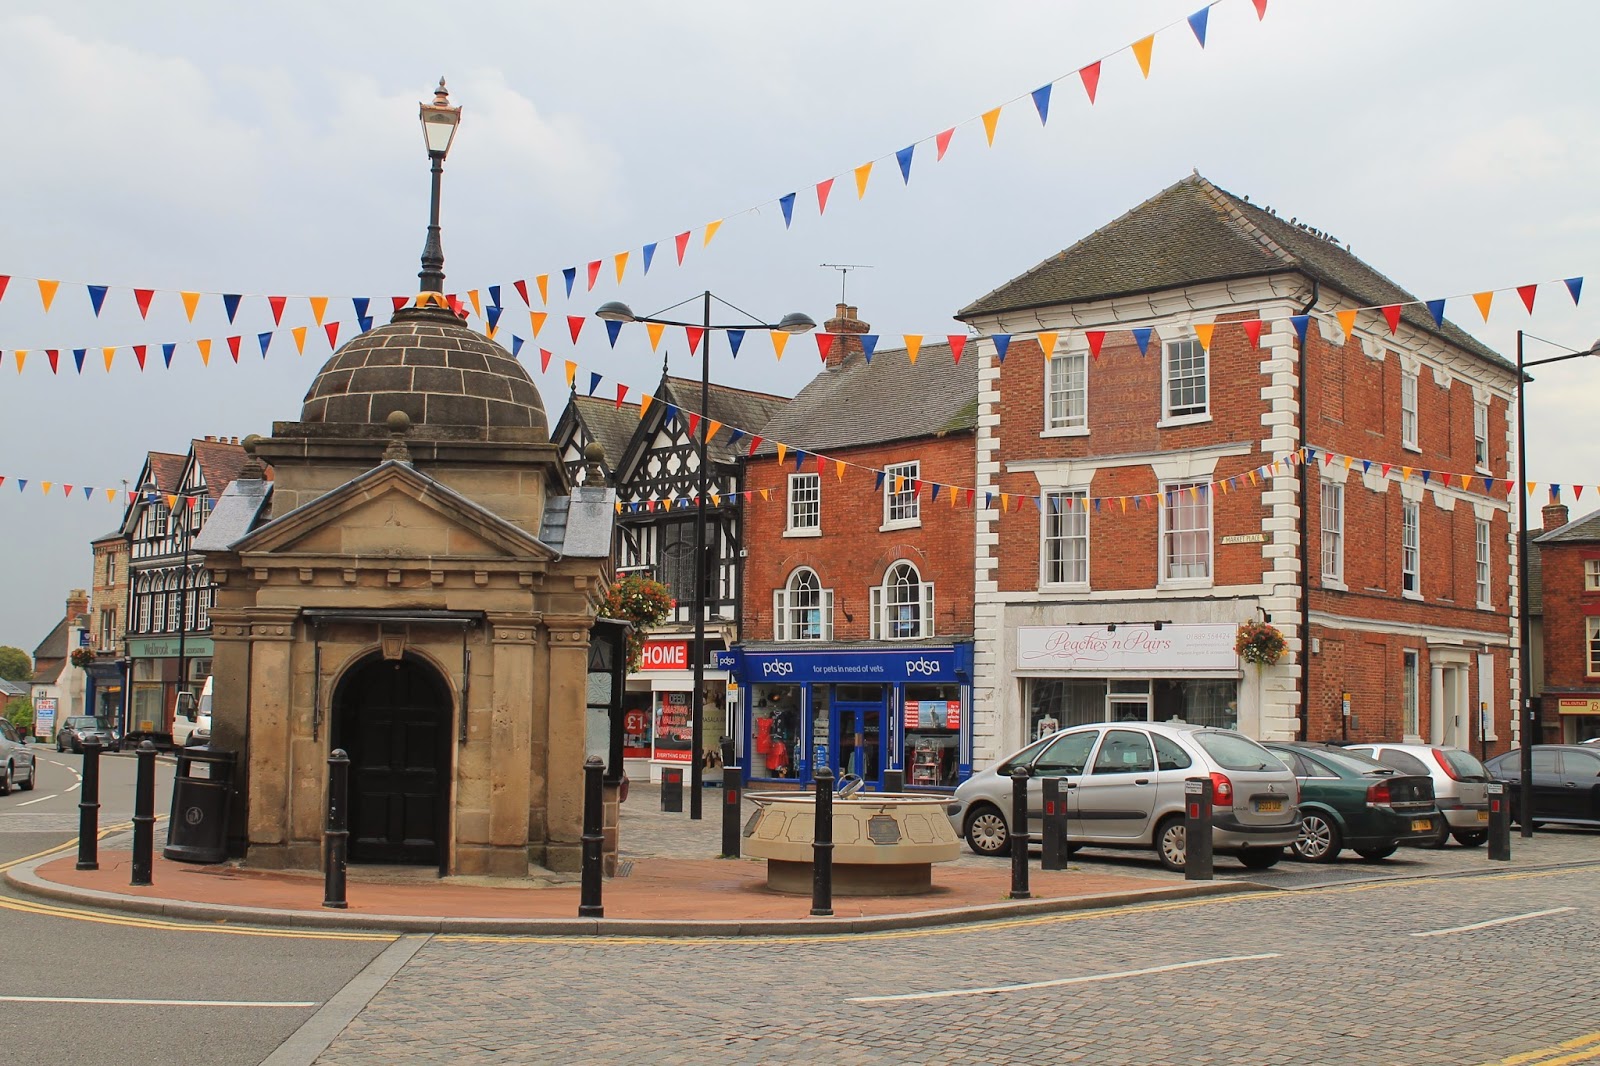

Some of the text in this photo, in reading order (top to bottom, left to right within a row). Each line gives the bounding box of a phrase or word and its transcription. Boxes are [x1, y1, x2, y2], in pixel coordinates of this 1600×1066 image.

[1226, 535, 1245, 543] MARKET
[1045, 629, 1171, 655] Peaches n Pairs
[642, 645, 685, 665] HOME
[719, 656, 736, 666] pdsa
[763, 658, 793, 677] pdsa
[812, 664, 884, 674] for pets in need of vets
[905, 656, 941, 677] pdsa
